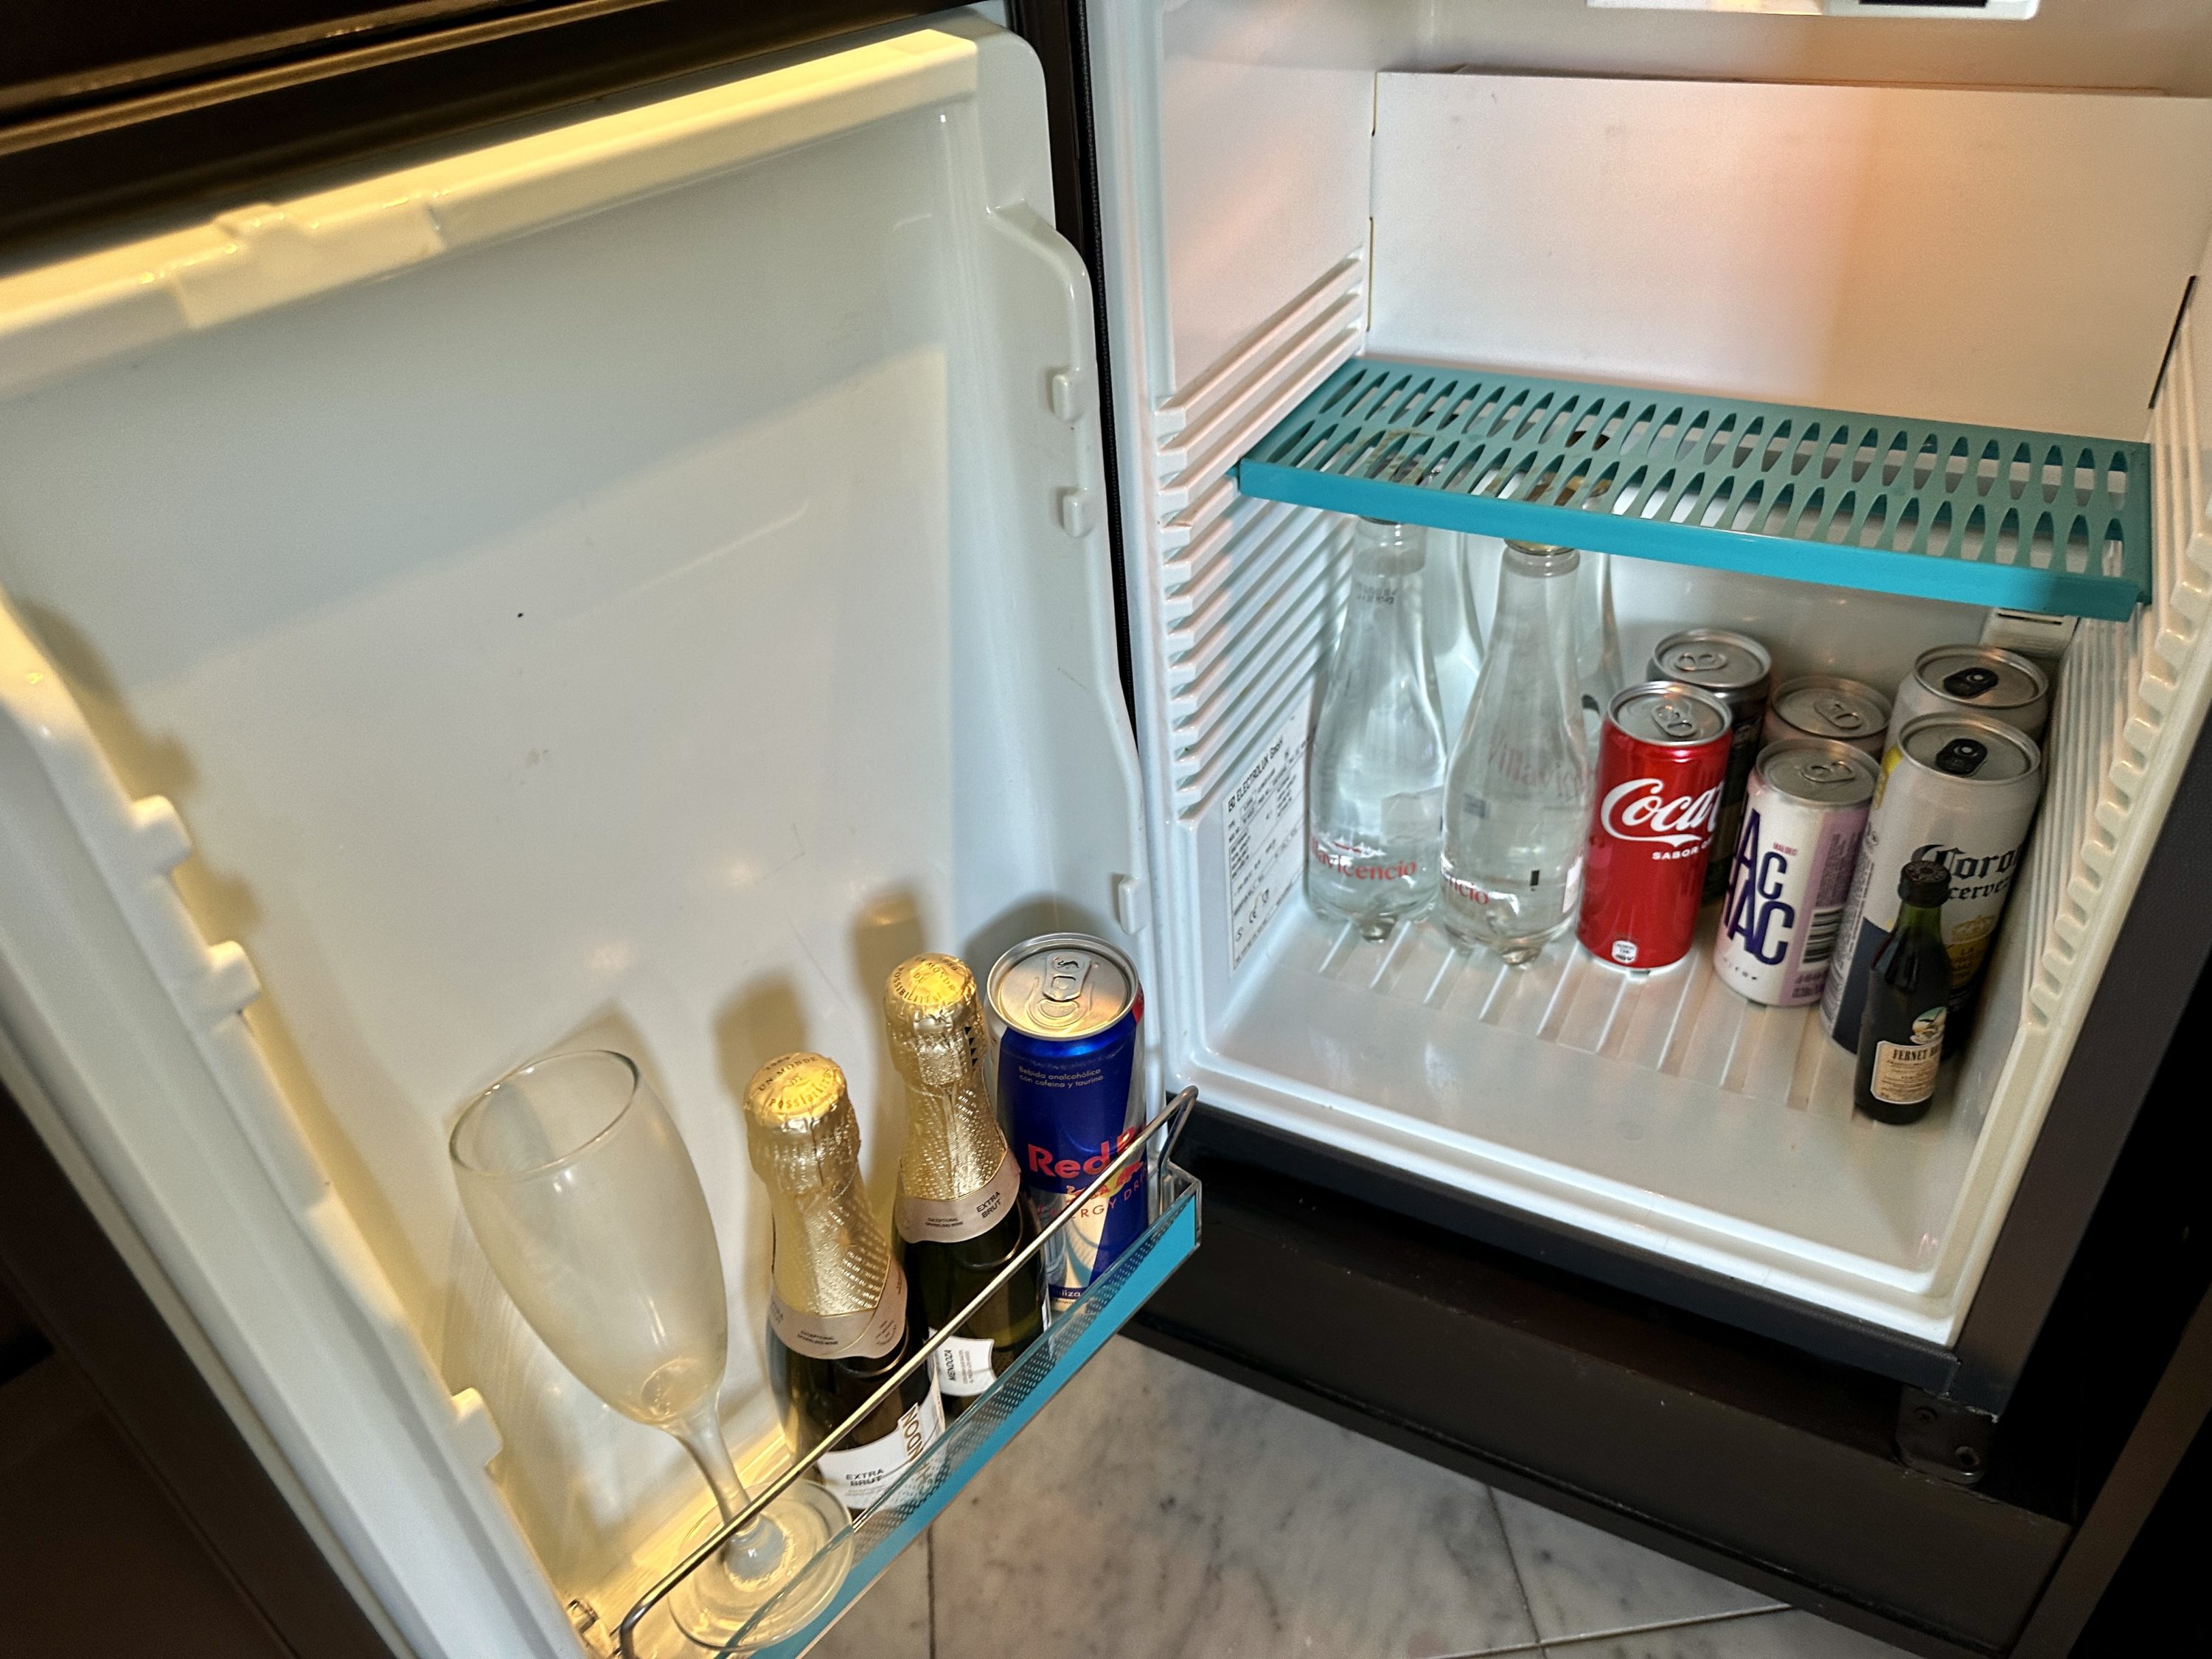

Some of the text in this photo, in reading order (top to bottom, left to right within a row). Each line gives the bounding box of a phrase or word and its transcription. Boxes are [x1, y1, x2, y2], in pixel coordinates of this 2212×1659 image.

[1652, 846, 1699, 861] SABOR
[776, 1056, 818, 1077] MONDE
[1018, 1065, 1046, 1079] Bebida
[1019, 1074, 1033, 1083] con
[1075, 1075, 1104, 1086] taurina
[1028, 1140, 1110, 1179] Red
[975, 1191, 1001, 1213] EXTRA
[981, 1198, 1001, 1219] BRUT
[944, 1349, 956, 1382] MENDOZA
[846, 1468, 884, 1481] EXTRA
